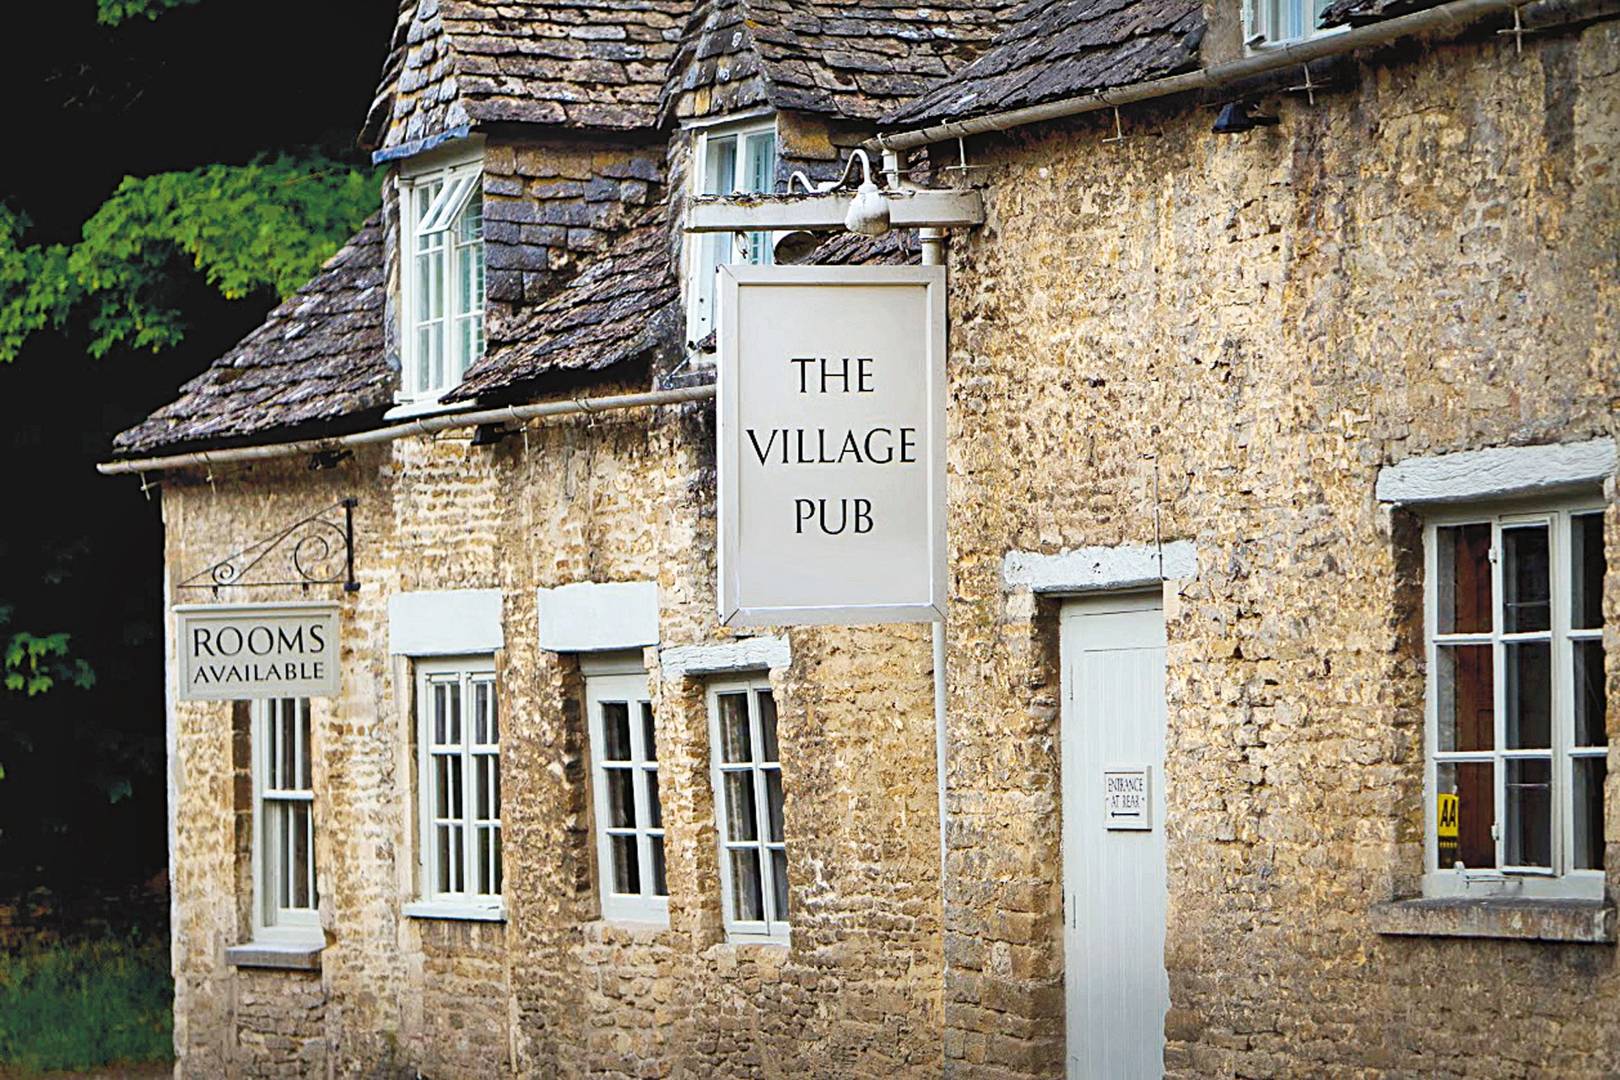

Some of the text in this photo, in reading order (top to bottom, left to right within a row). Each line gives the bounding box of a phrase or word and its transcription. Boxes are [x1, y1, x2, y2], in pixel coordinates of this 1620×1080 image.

[791, 358, 874, 393] THE
[746, 428, 916, 465] VILLAGE
[795, 498, 874, 535] PUB
[193, 624, 325, 657] ROOMS
[194, 662, 324, 684] AVAILABLE
[1108, 777, 1143, 793] ENTRANCE
[1111, 795, 1140, 808] AT REAR
[1440, 799, 1456, 827] AA
